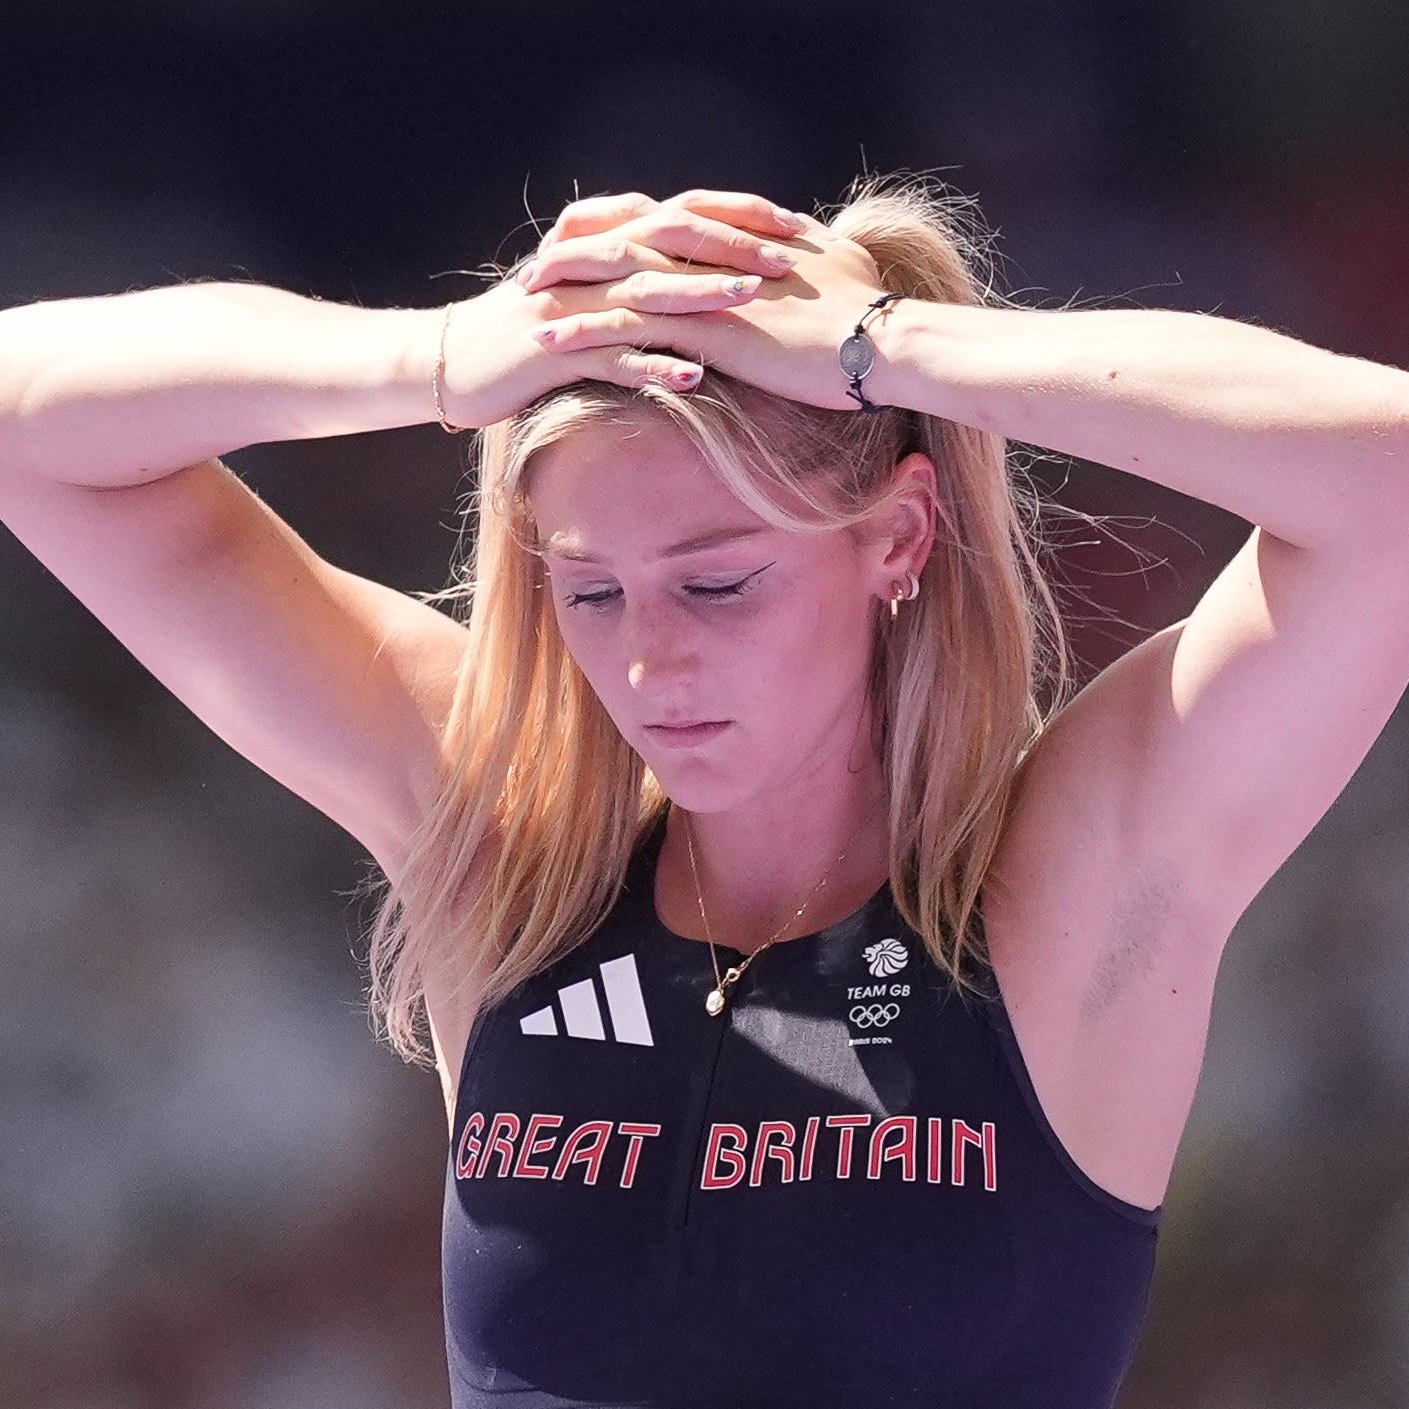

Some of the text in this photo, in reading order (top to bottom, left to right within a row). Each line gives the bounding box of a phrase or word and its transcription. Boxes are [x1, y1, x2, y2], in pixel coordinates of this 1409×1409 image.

[847, 984, 910, 1000] TEAM GB
[454, 1111, 998, 1193] GREAT BRITAIN
